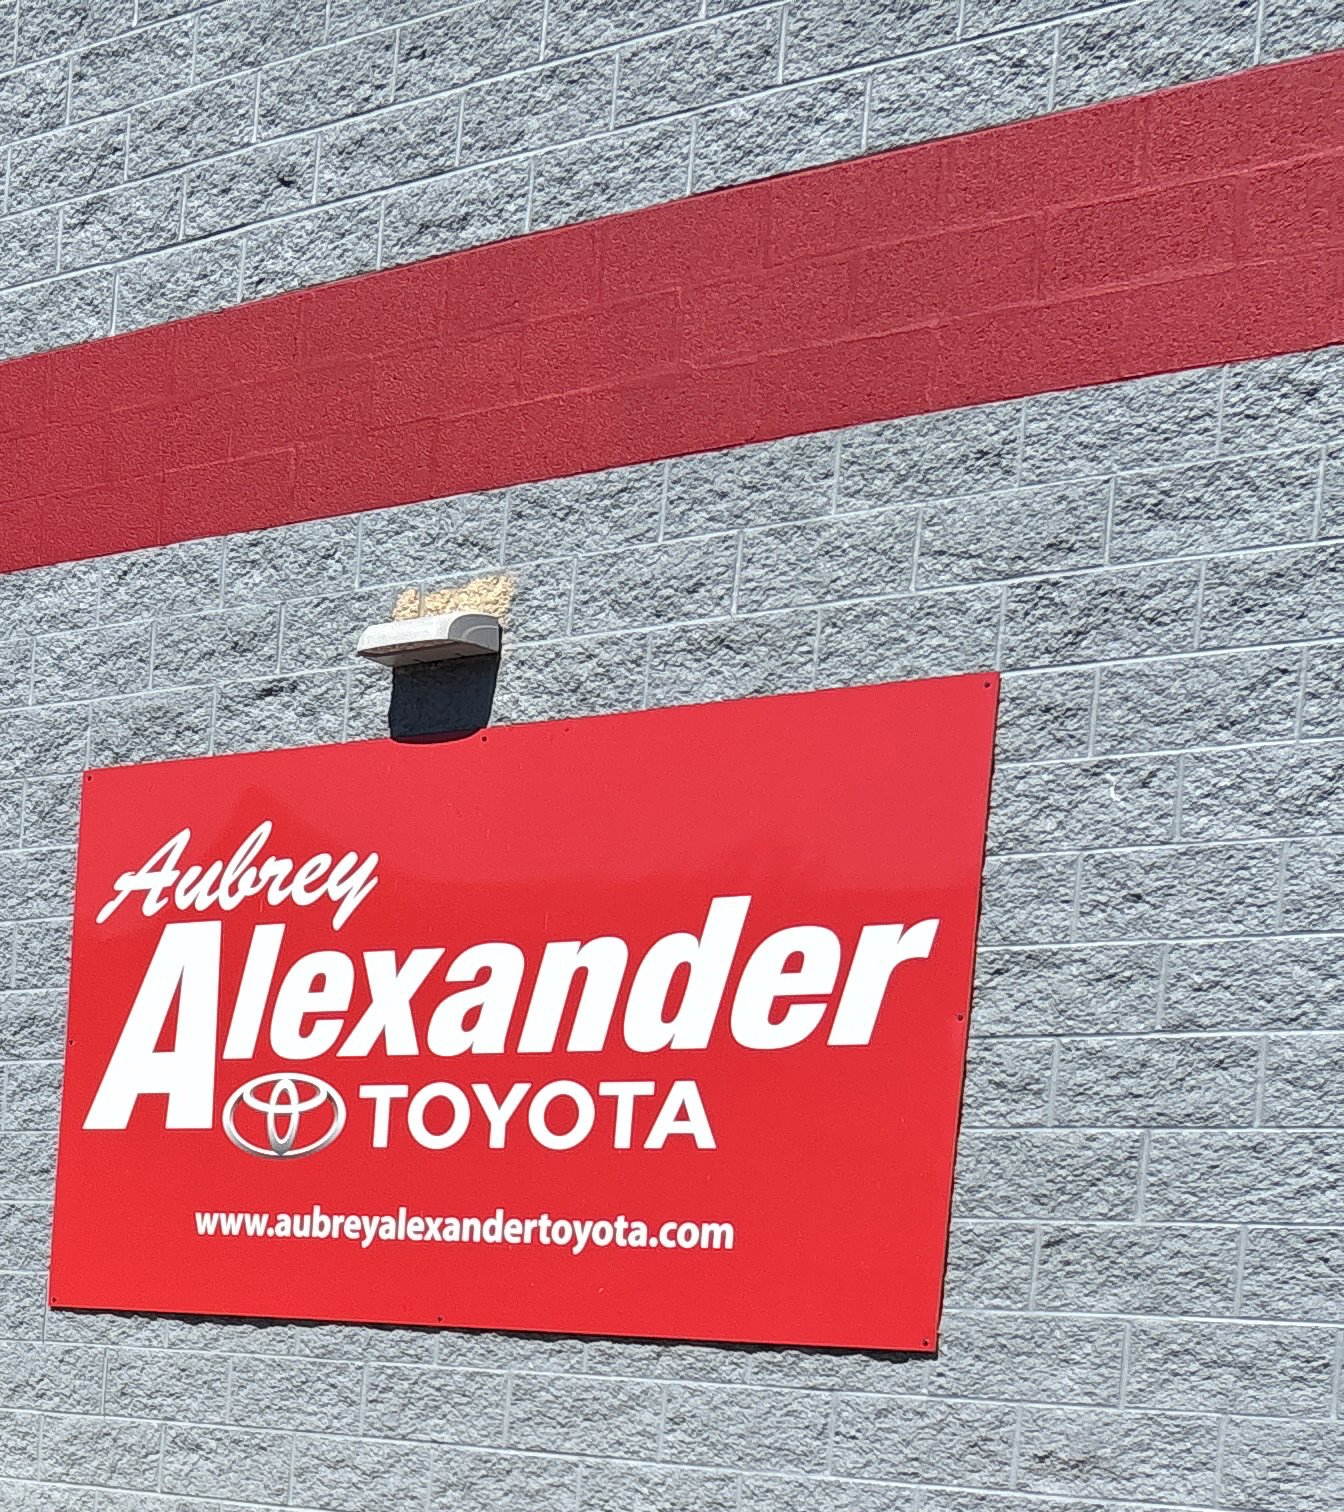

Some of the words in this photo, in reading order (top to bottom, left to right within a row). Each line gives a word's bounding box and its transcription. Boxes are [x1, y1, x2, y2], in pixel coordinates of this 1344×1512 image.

[96, 821, 379, 931] Aubrey
[82, 895, 940, 1130] Alexander
[359, 1080, 717, 1150] TOYOTA
[194, 1205, 734, 1255] www.aubreyalexandertoyota.com
